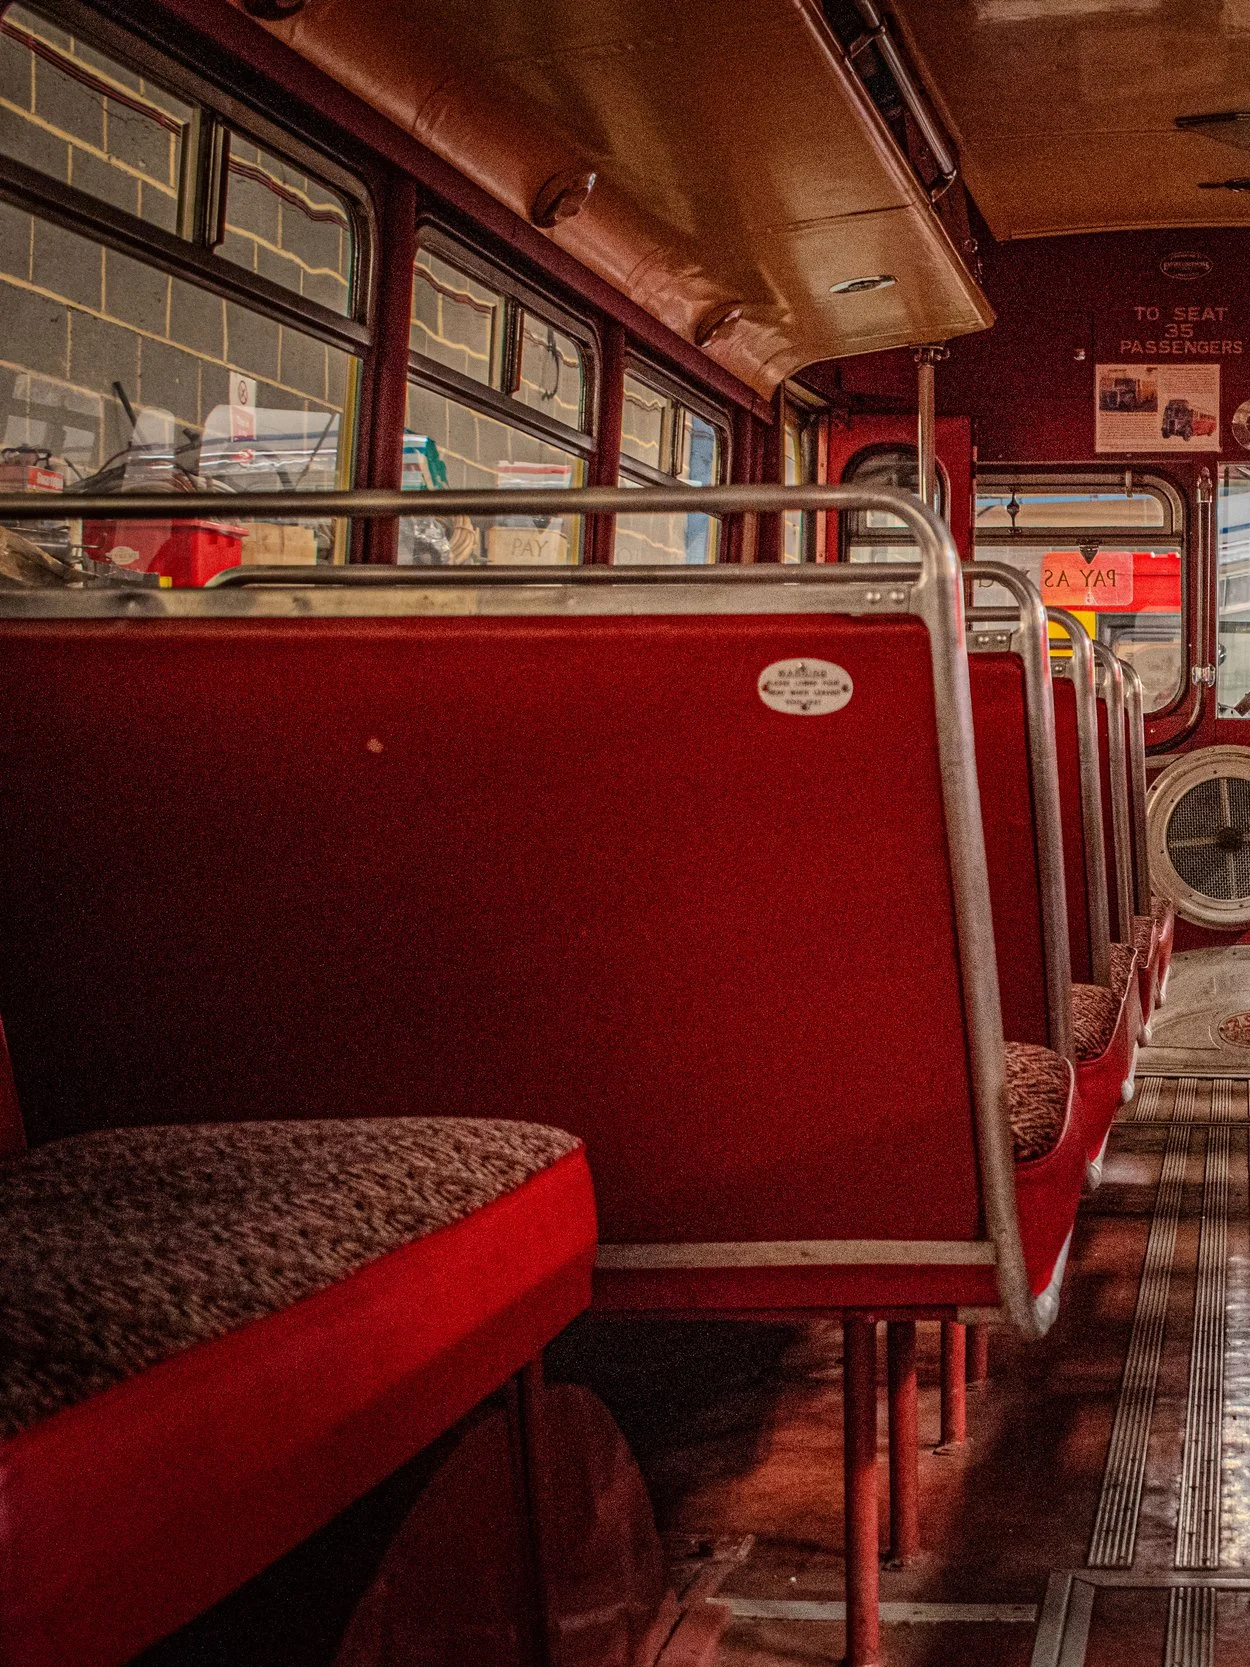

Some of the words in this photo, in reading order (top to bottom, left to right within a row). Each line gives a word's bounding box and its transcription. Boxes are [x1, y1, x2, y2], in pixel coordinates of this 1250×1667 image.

[1133, 306, 1160, 322] TO
[1173, 306, 1228, 322] SEAT
[1164, 323, 1194, 338] 35
[1119, 340, 1243, 355] PASSENGERS
[511, 538, 549, 557] PAY
